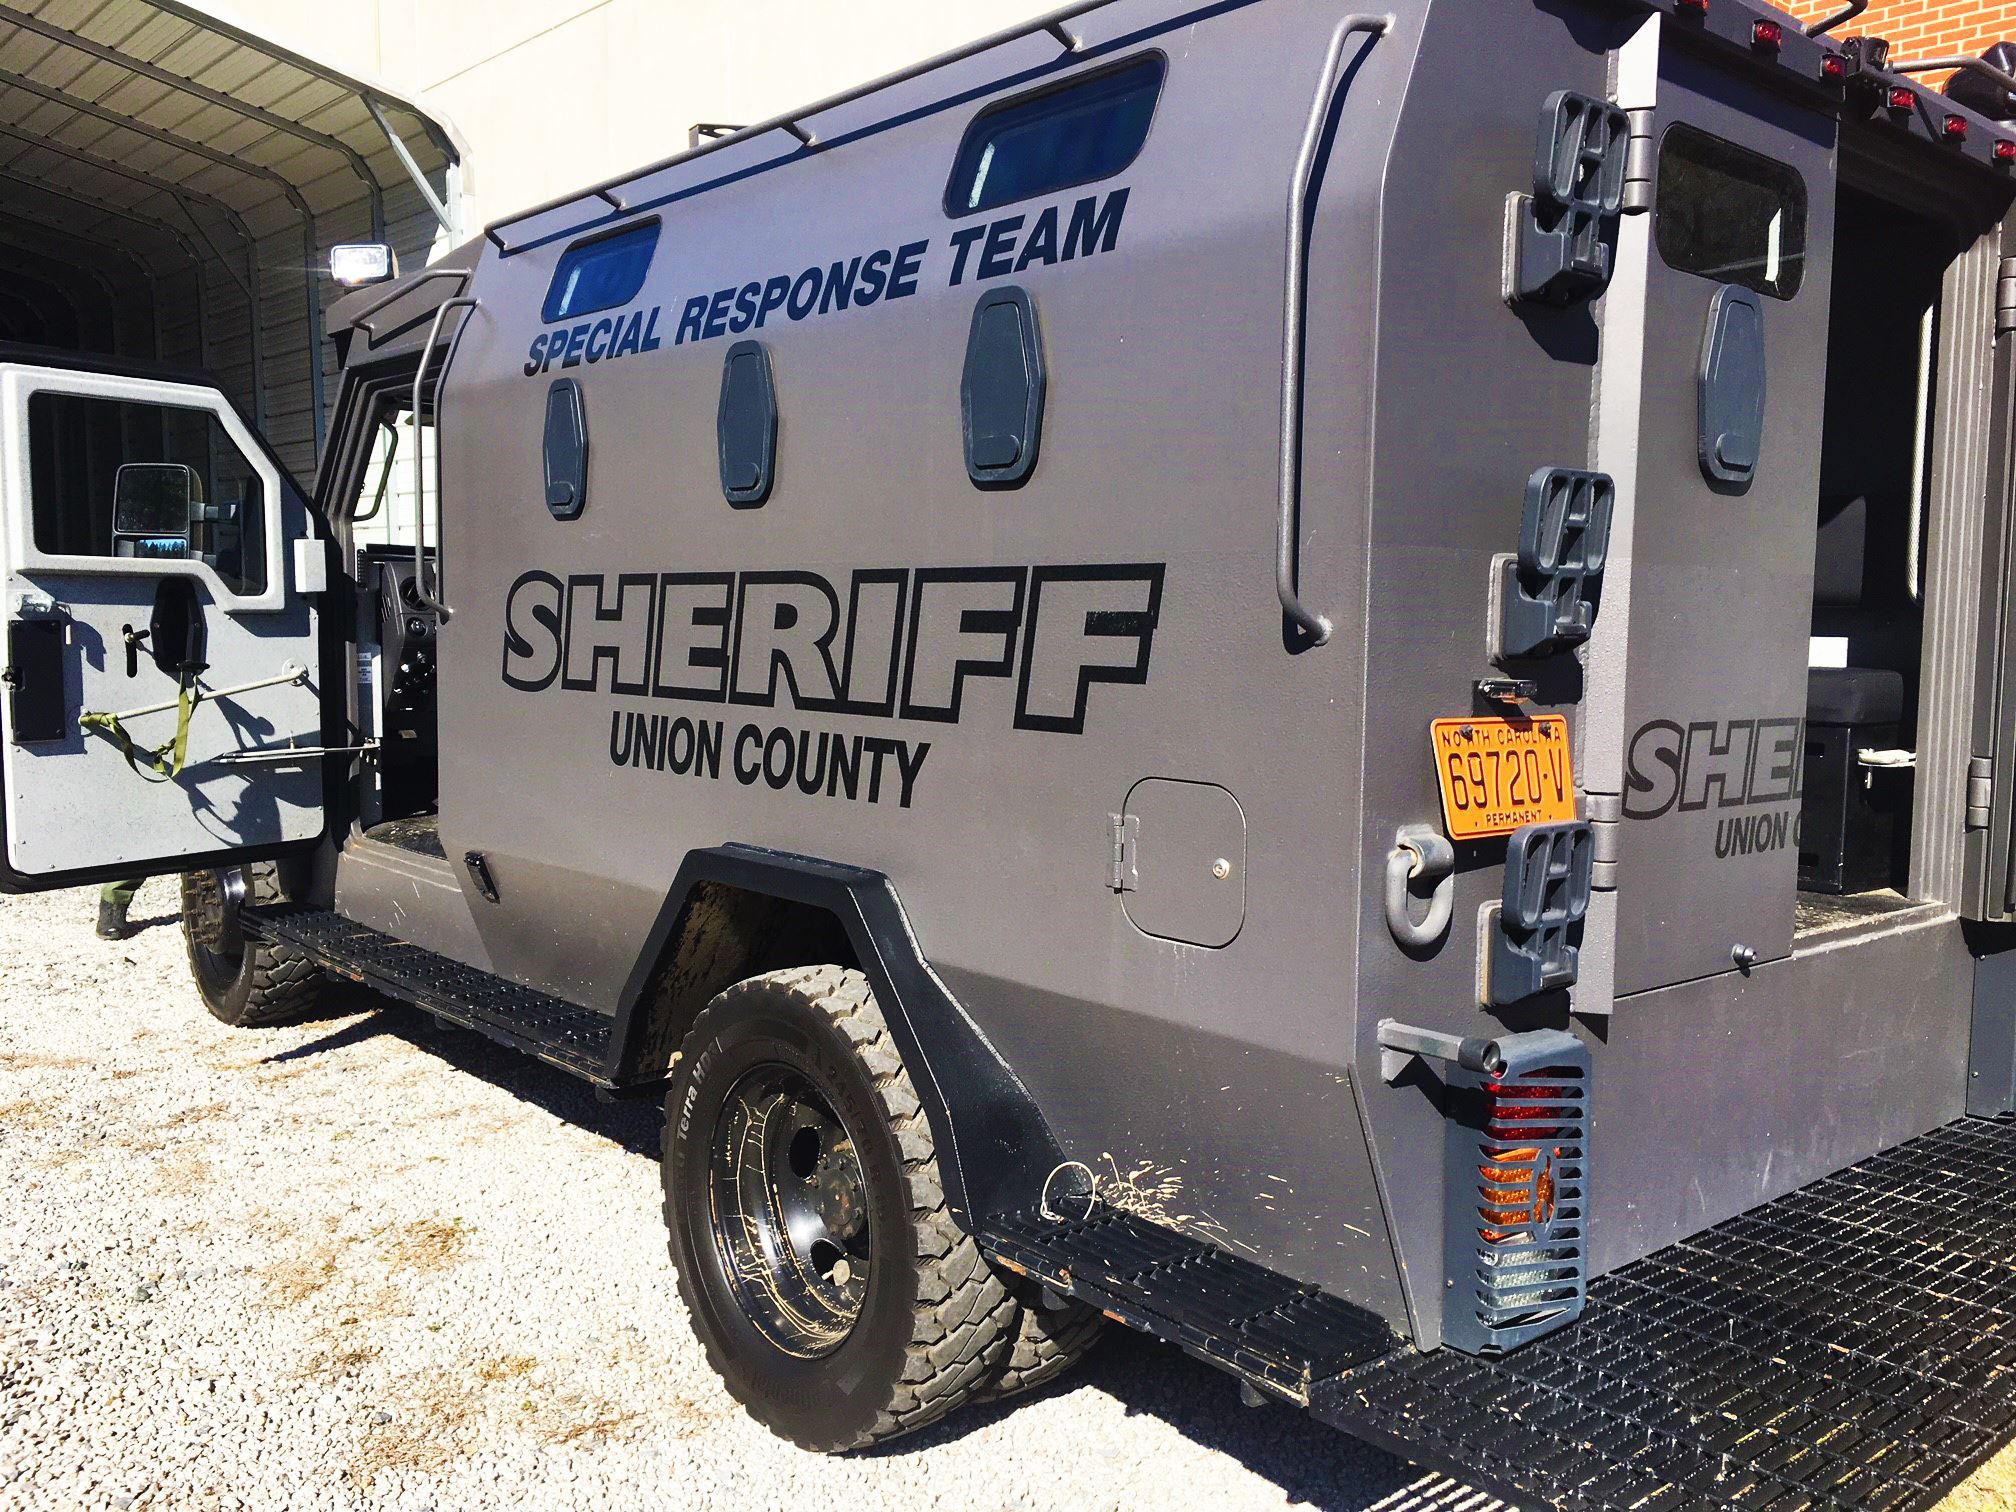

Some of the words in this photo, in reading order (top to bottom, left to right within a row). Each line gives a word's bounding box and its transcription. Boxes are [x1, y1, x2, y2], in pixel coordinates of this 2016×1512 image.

[523, 304, 661, 377] SPECIAL
[674, 239, 930, 346] RESPONSE
[947, 187, 1132, 286] TEAM
[502, 562, 1167, 735] SHERIFF
[610, 711, 724, 779] UNION
[733, 724, 932, 808] COUNTY
[1621, 717, 1806, 821] SHE
[1486, 810, 1542, 826] PERMANENT
[1714, 811, 1789, 859] UNION
[676, 1084, 699, 1141] Terra
